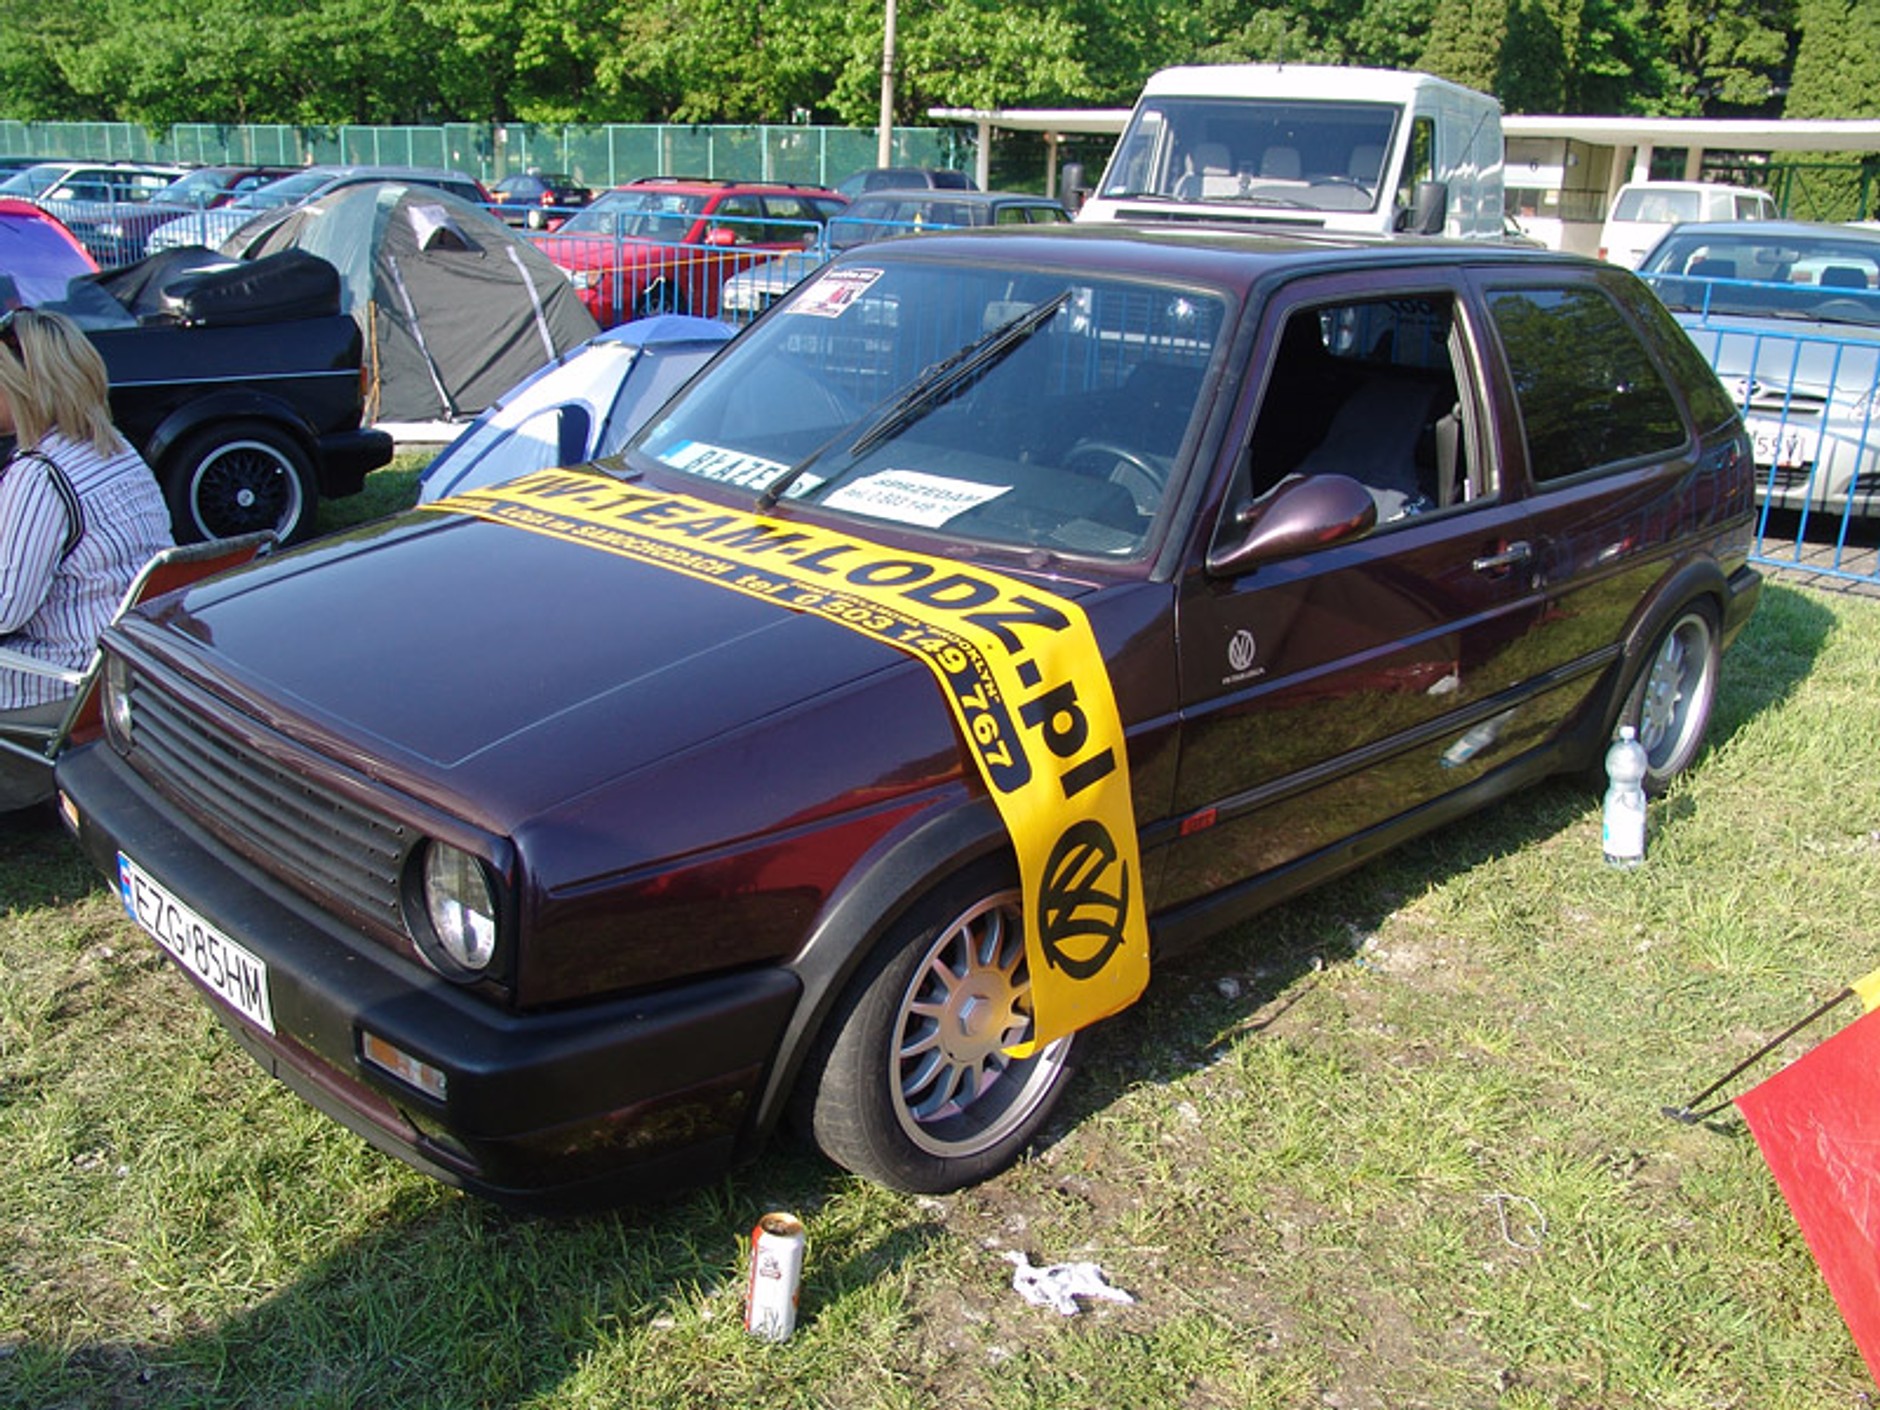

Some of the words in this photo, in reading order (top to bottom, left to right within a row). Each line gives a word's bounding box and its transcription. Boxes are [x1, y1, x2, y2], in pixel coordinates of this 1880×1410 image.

[793, 593, 823, 605] 0
[821, 600, 895, 630] 503
[897, 629, 968, 674] 149
[961, 683, 1014, 768] 767
[134, 875, 187, 954] EZG
[193, 924, 266, 1021] 85HM
